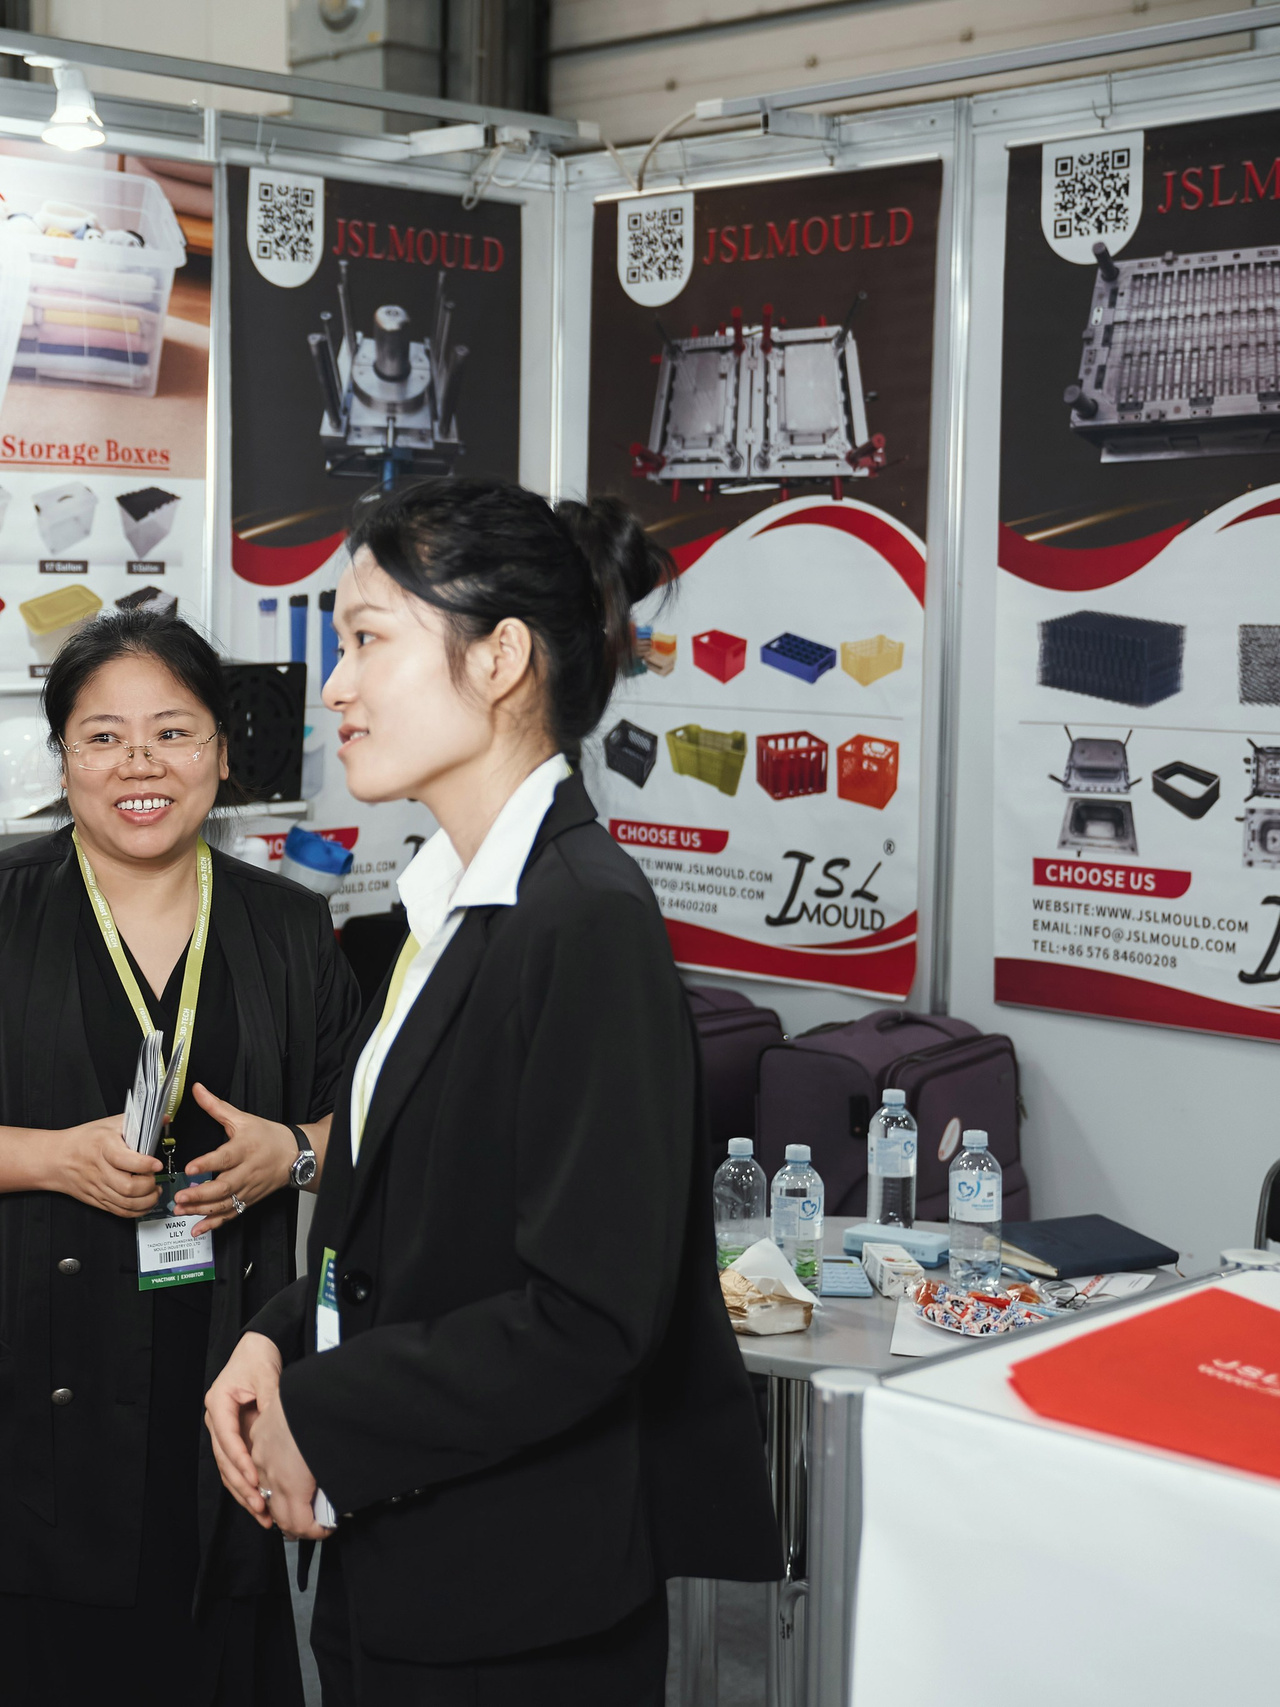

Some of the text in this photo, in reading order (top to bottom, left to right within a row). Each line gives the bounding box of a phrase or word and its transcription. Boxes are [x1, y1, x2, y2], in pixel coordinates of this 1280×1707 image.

[331, 217, 505, 274] JSLMOULD
[702, 206, 915, 266] JSLMOULD
[1, 434, 99, 466] Storage
[106, 438, 171, 466] Boxes
[616, 823, 703, 849] CHOOSE US
[1045, 864, 1156, 892] CHOOSE US
[92, 888, 107, 917] rosplast
[103, 918, 119, 949] 3D-TECH
[194, 915, 206, 951] rosmould
[200, 855, 208, 883] 3D-TECH
[667, 897, 718, 914] 84600208
[800, 900, 886, 932] MOULD
[1032, 898, 1250, 934] WEBSITE:WWW.JSLMOULD.COM
[1032, 918, 1237, 955] EMAIL:INFO@JSLMOULD.COM
[1032, 939, 1178, 970] TEL:+86 576 84600208
[179, 1007, 191, 1037] 3D-TECH
[165, 1220, 187, 1230] WANG
[169, 1230, 184, 1239] LILY
[180, 1271, 205, 1280] EXHIBITOR
